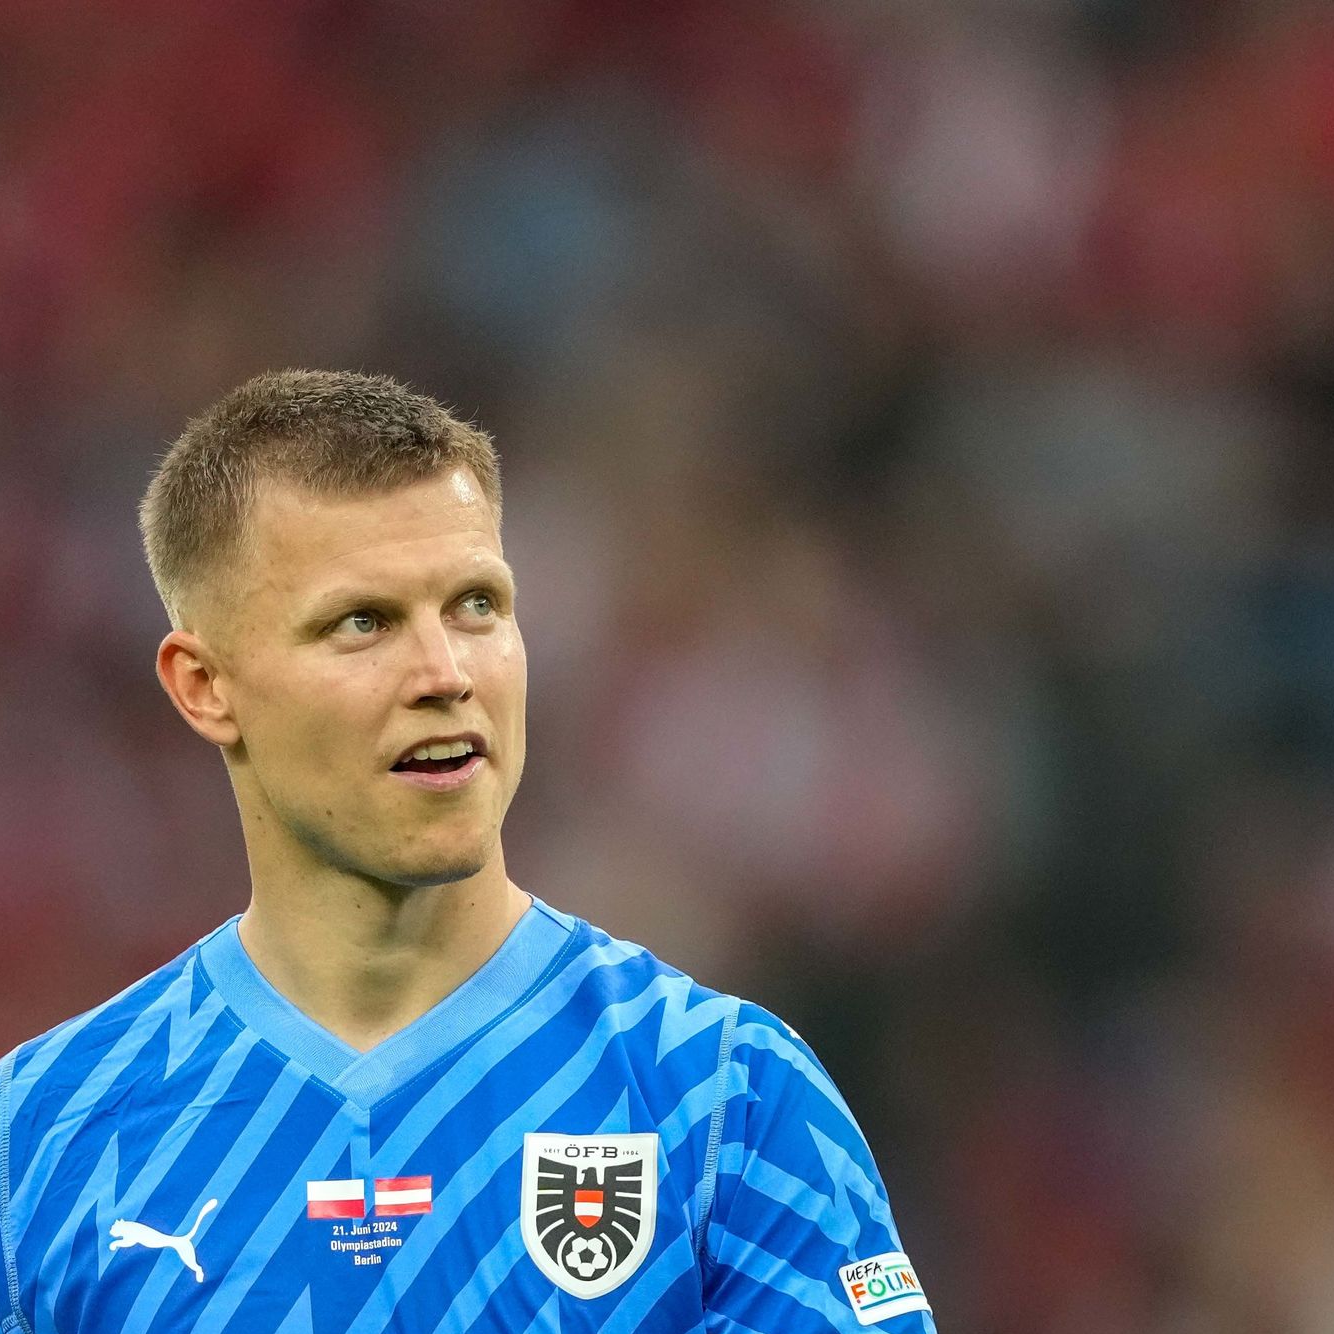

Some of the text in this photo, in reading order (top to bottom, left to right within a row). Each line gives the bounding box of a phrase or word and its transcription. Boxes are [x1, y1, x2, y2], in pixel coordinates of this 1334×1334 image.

[564, 1143, 618, 1158] ÖFB
[333, 1221, 397, 1236] 21. Juni 2024
[330, 1237, 402, 1252] Olympiastadion
[354, 1254, 382, 1266] Berlin
[846, 1262, 882, 1282] UEFA
[851, 1271, 917, 1304] FOUN
